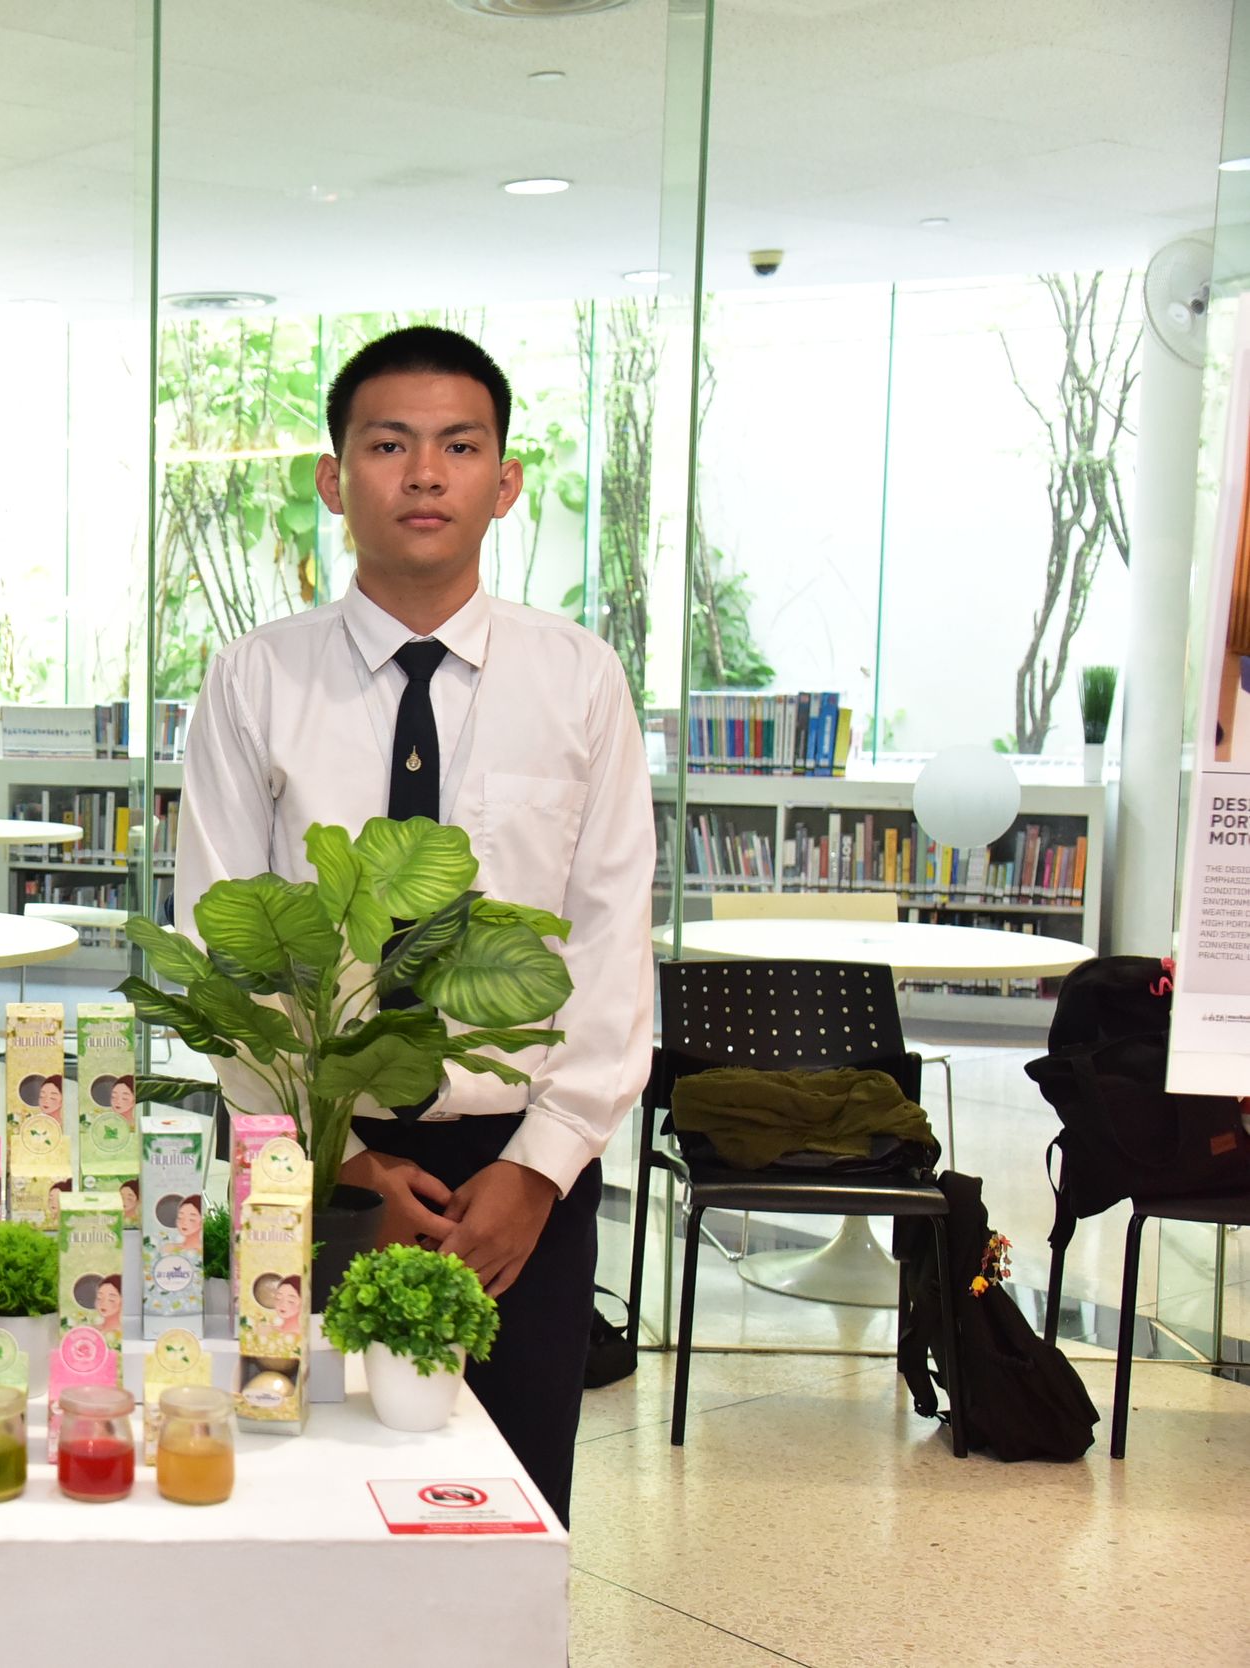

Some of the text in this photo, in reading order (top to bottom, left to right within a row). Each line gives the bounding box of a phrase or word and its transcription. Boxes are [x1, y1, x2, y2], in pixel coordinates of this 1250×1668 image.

[1211, 814, 1250, 829] POR
[1209, 831, 1250, 846] MOT
[1206, 865, 1223, 873] THE
[1201, 919, 1223, 927] HIGH
[1200, 930, 1218, 938] AND
